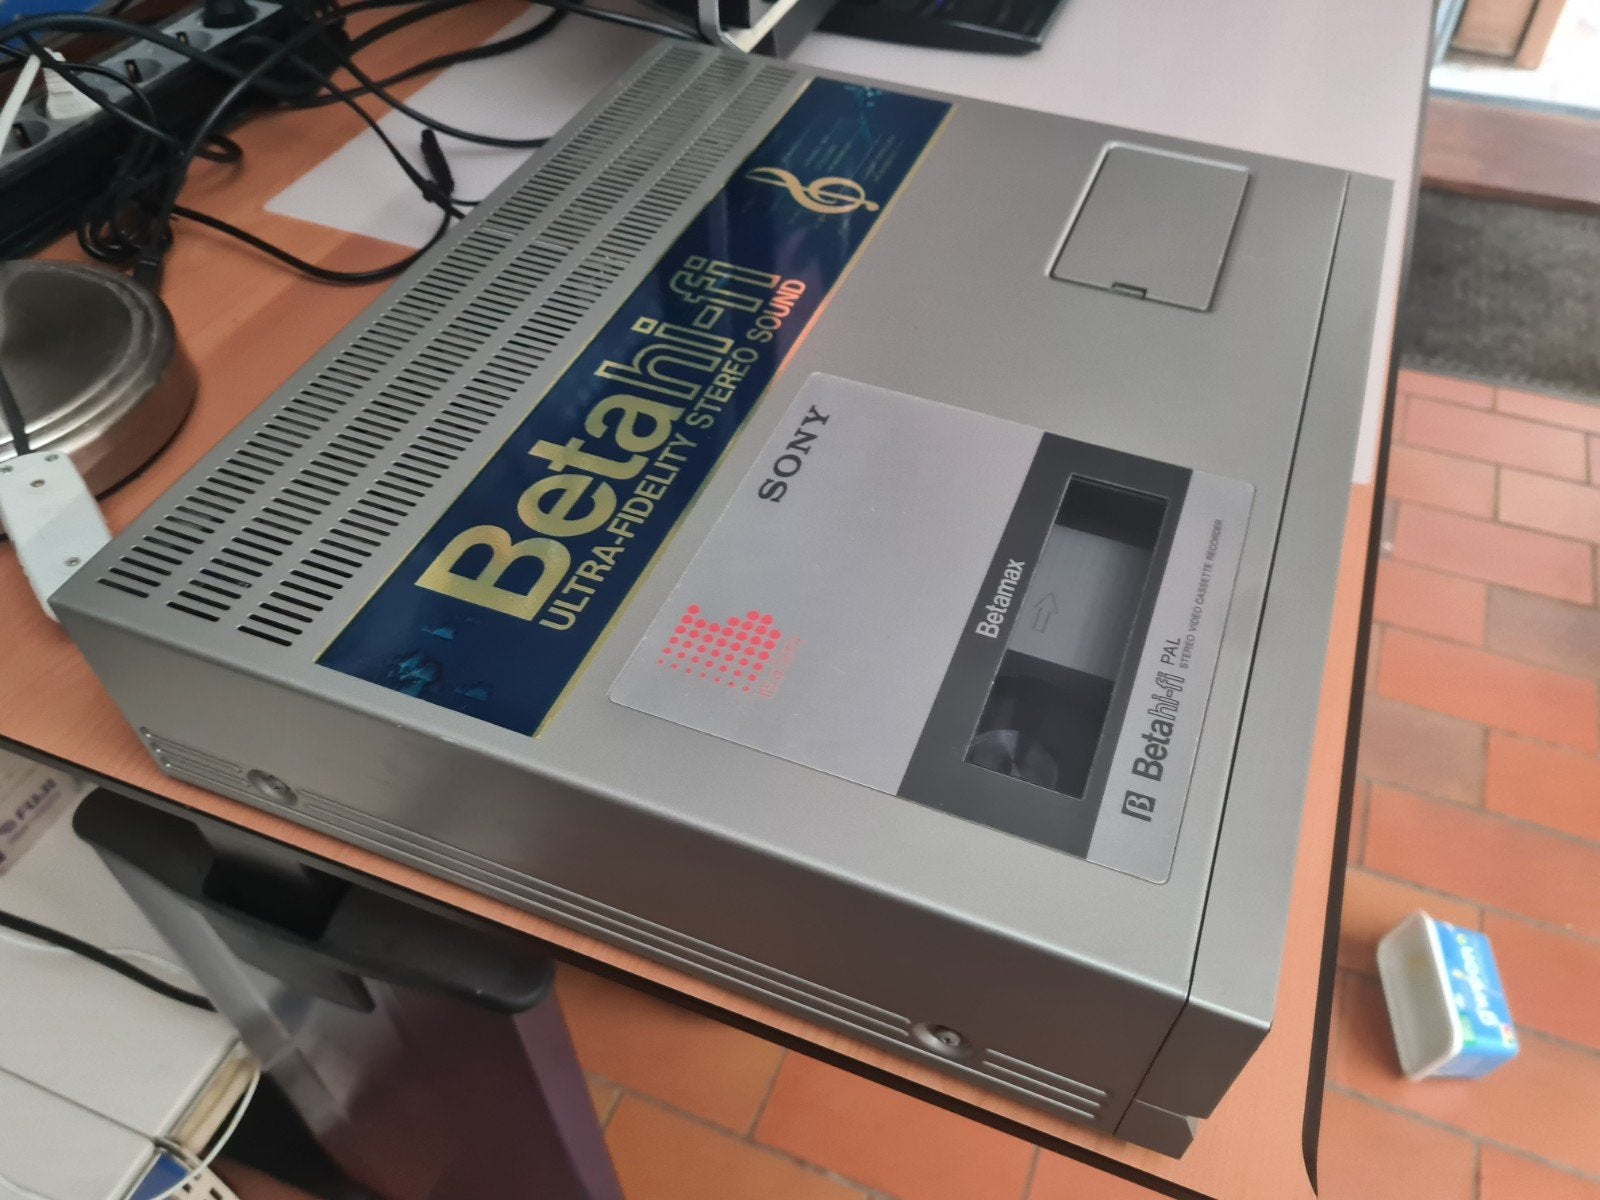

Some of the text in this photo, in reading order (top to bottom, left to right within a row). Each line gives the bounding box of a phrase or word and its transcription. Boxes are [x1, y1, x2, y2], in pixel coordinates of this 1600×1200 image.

[538, 278, 807, 631] ULTRA-FIDELITY STEREO SOUND
[758, 405, 830, 503] SONY
[975, 558, 1026, 639] Betamax
[1179, 519, 1223, 669] STEREO VIDEO CASSETTE RECORDER
[1160, 637, 1181, 666] PAL
